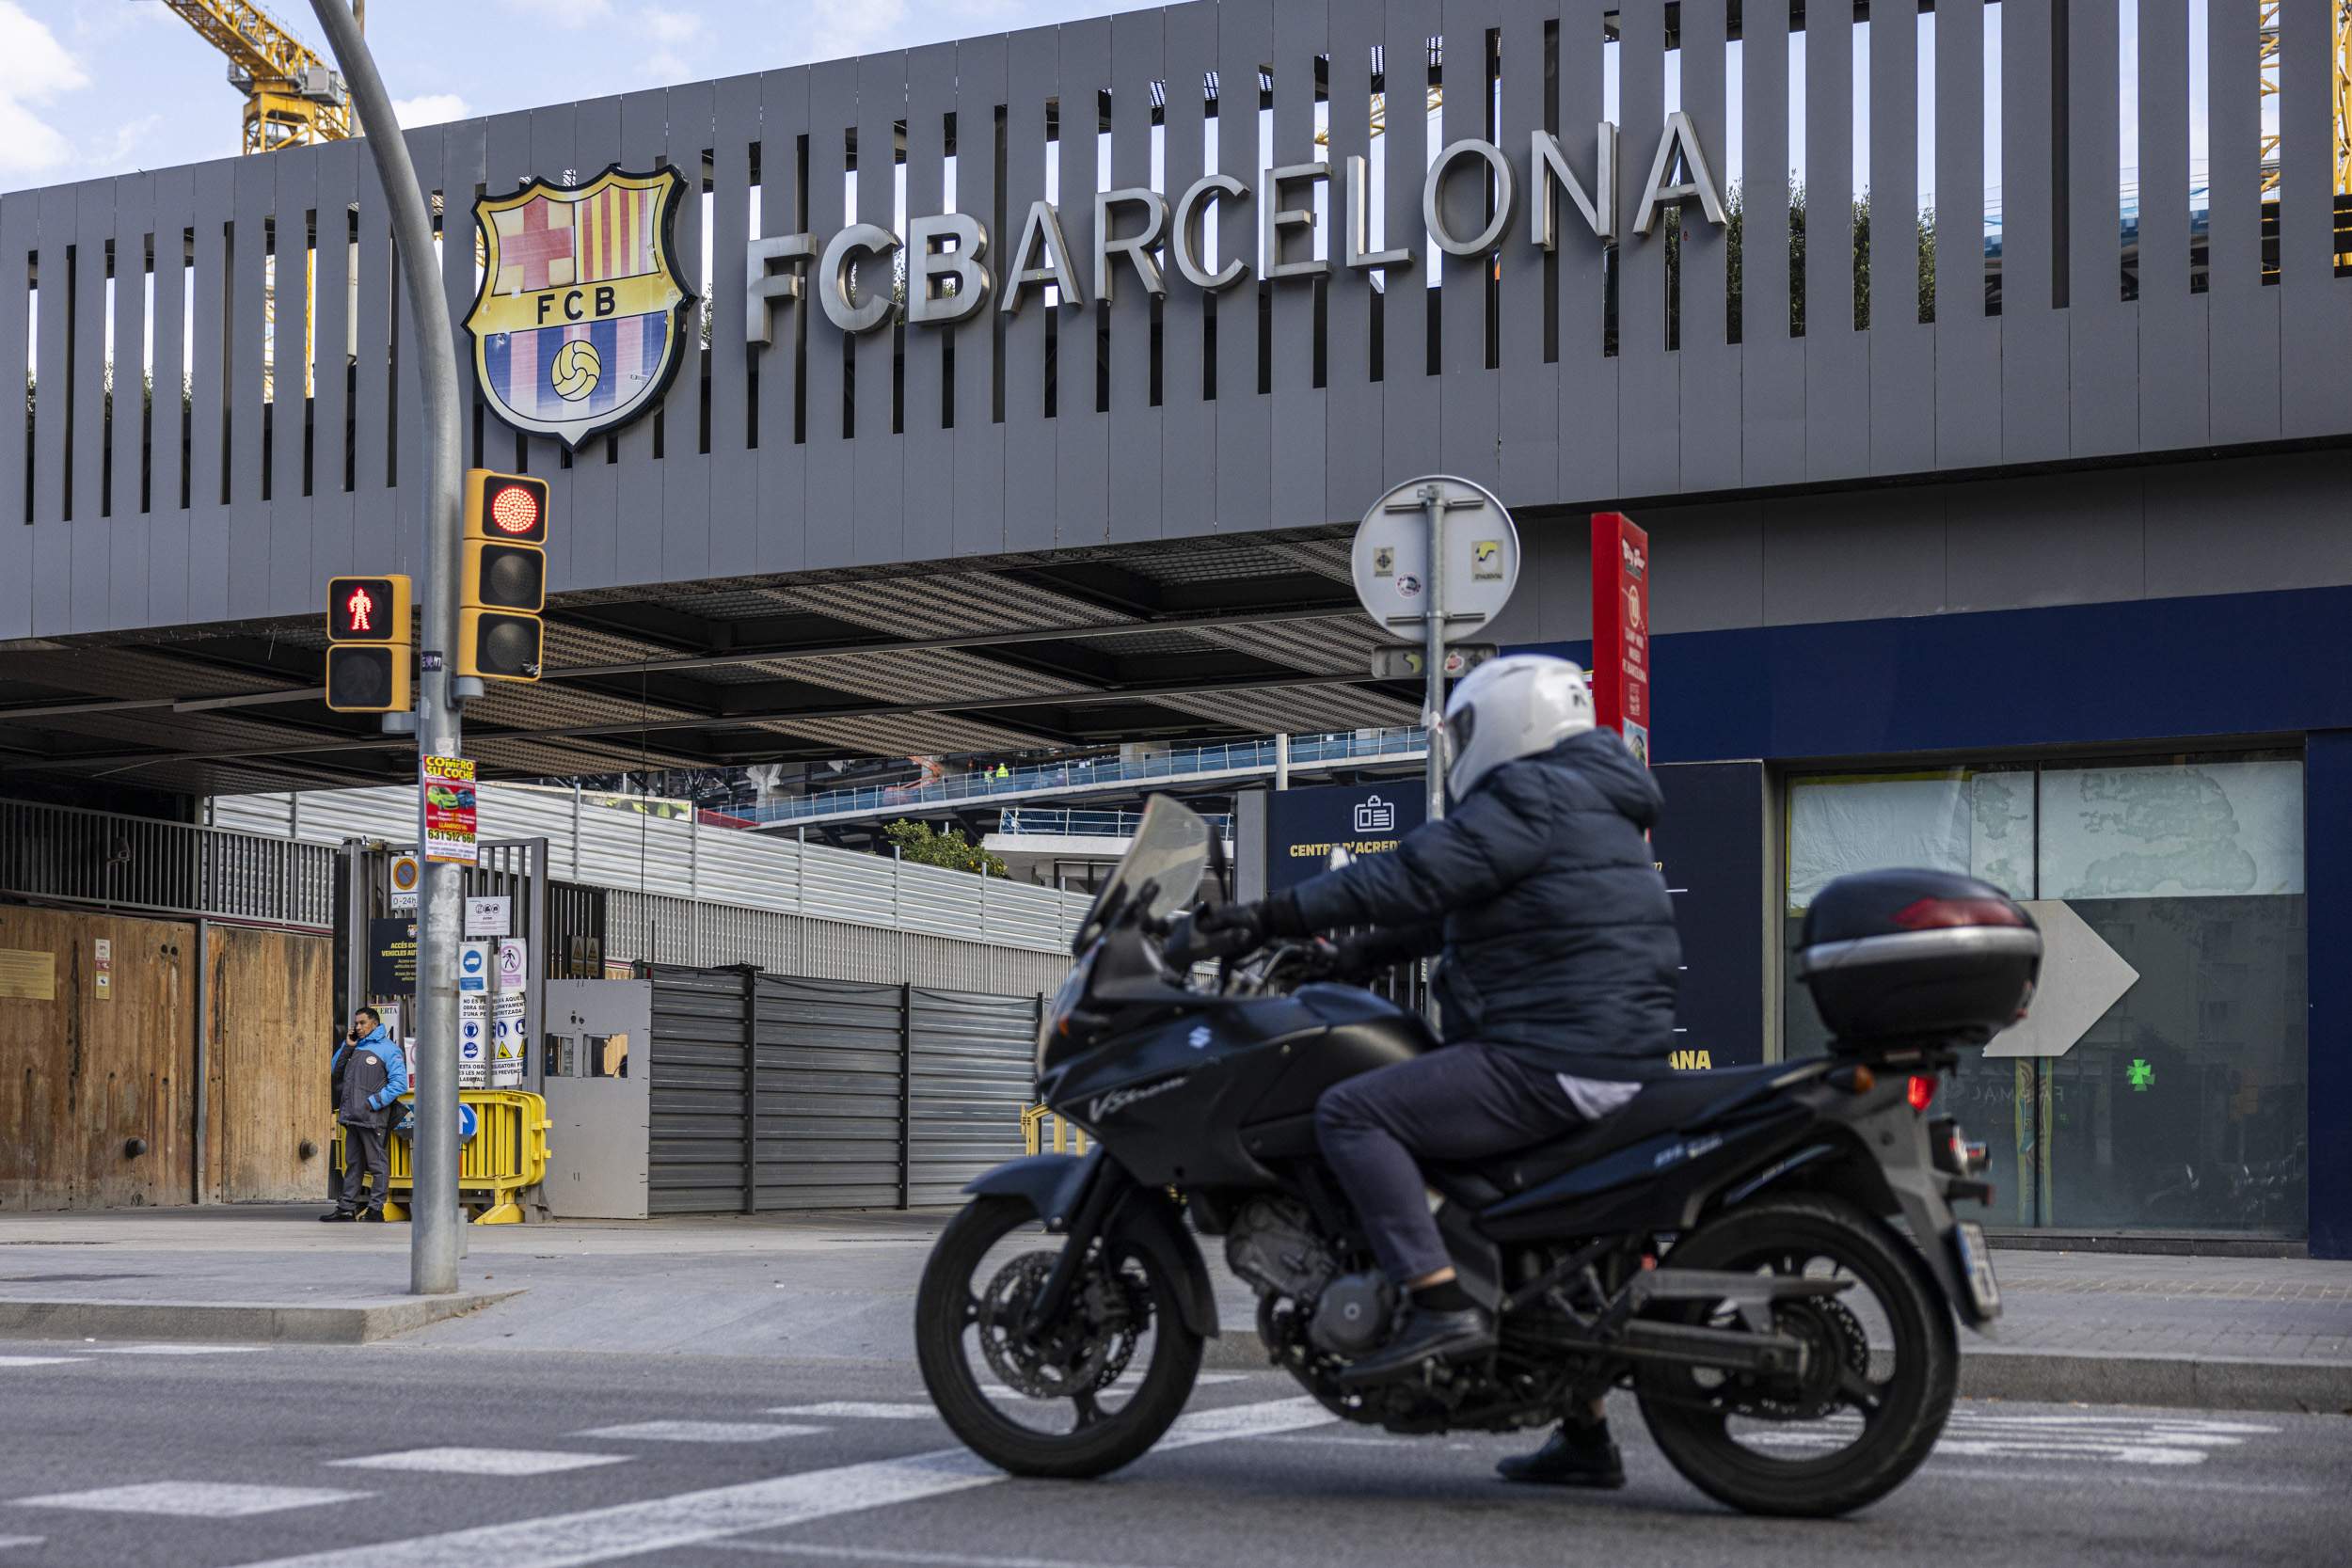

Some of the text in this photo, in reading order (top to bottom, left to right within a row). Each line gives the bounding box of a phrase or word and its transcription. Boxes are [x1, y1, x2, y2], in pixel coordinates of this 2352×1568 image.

[425, 756, 474, 771] COMPRO
[426, 766, 474, 781] SU COCHE
[1290, 840, 1402, 857] CENTR D'ACRED
[1669, 1050, 1711, 1070] ANA
